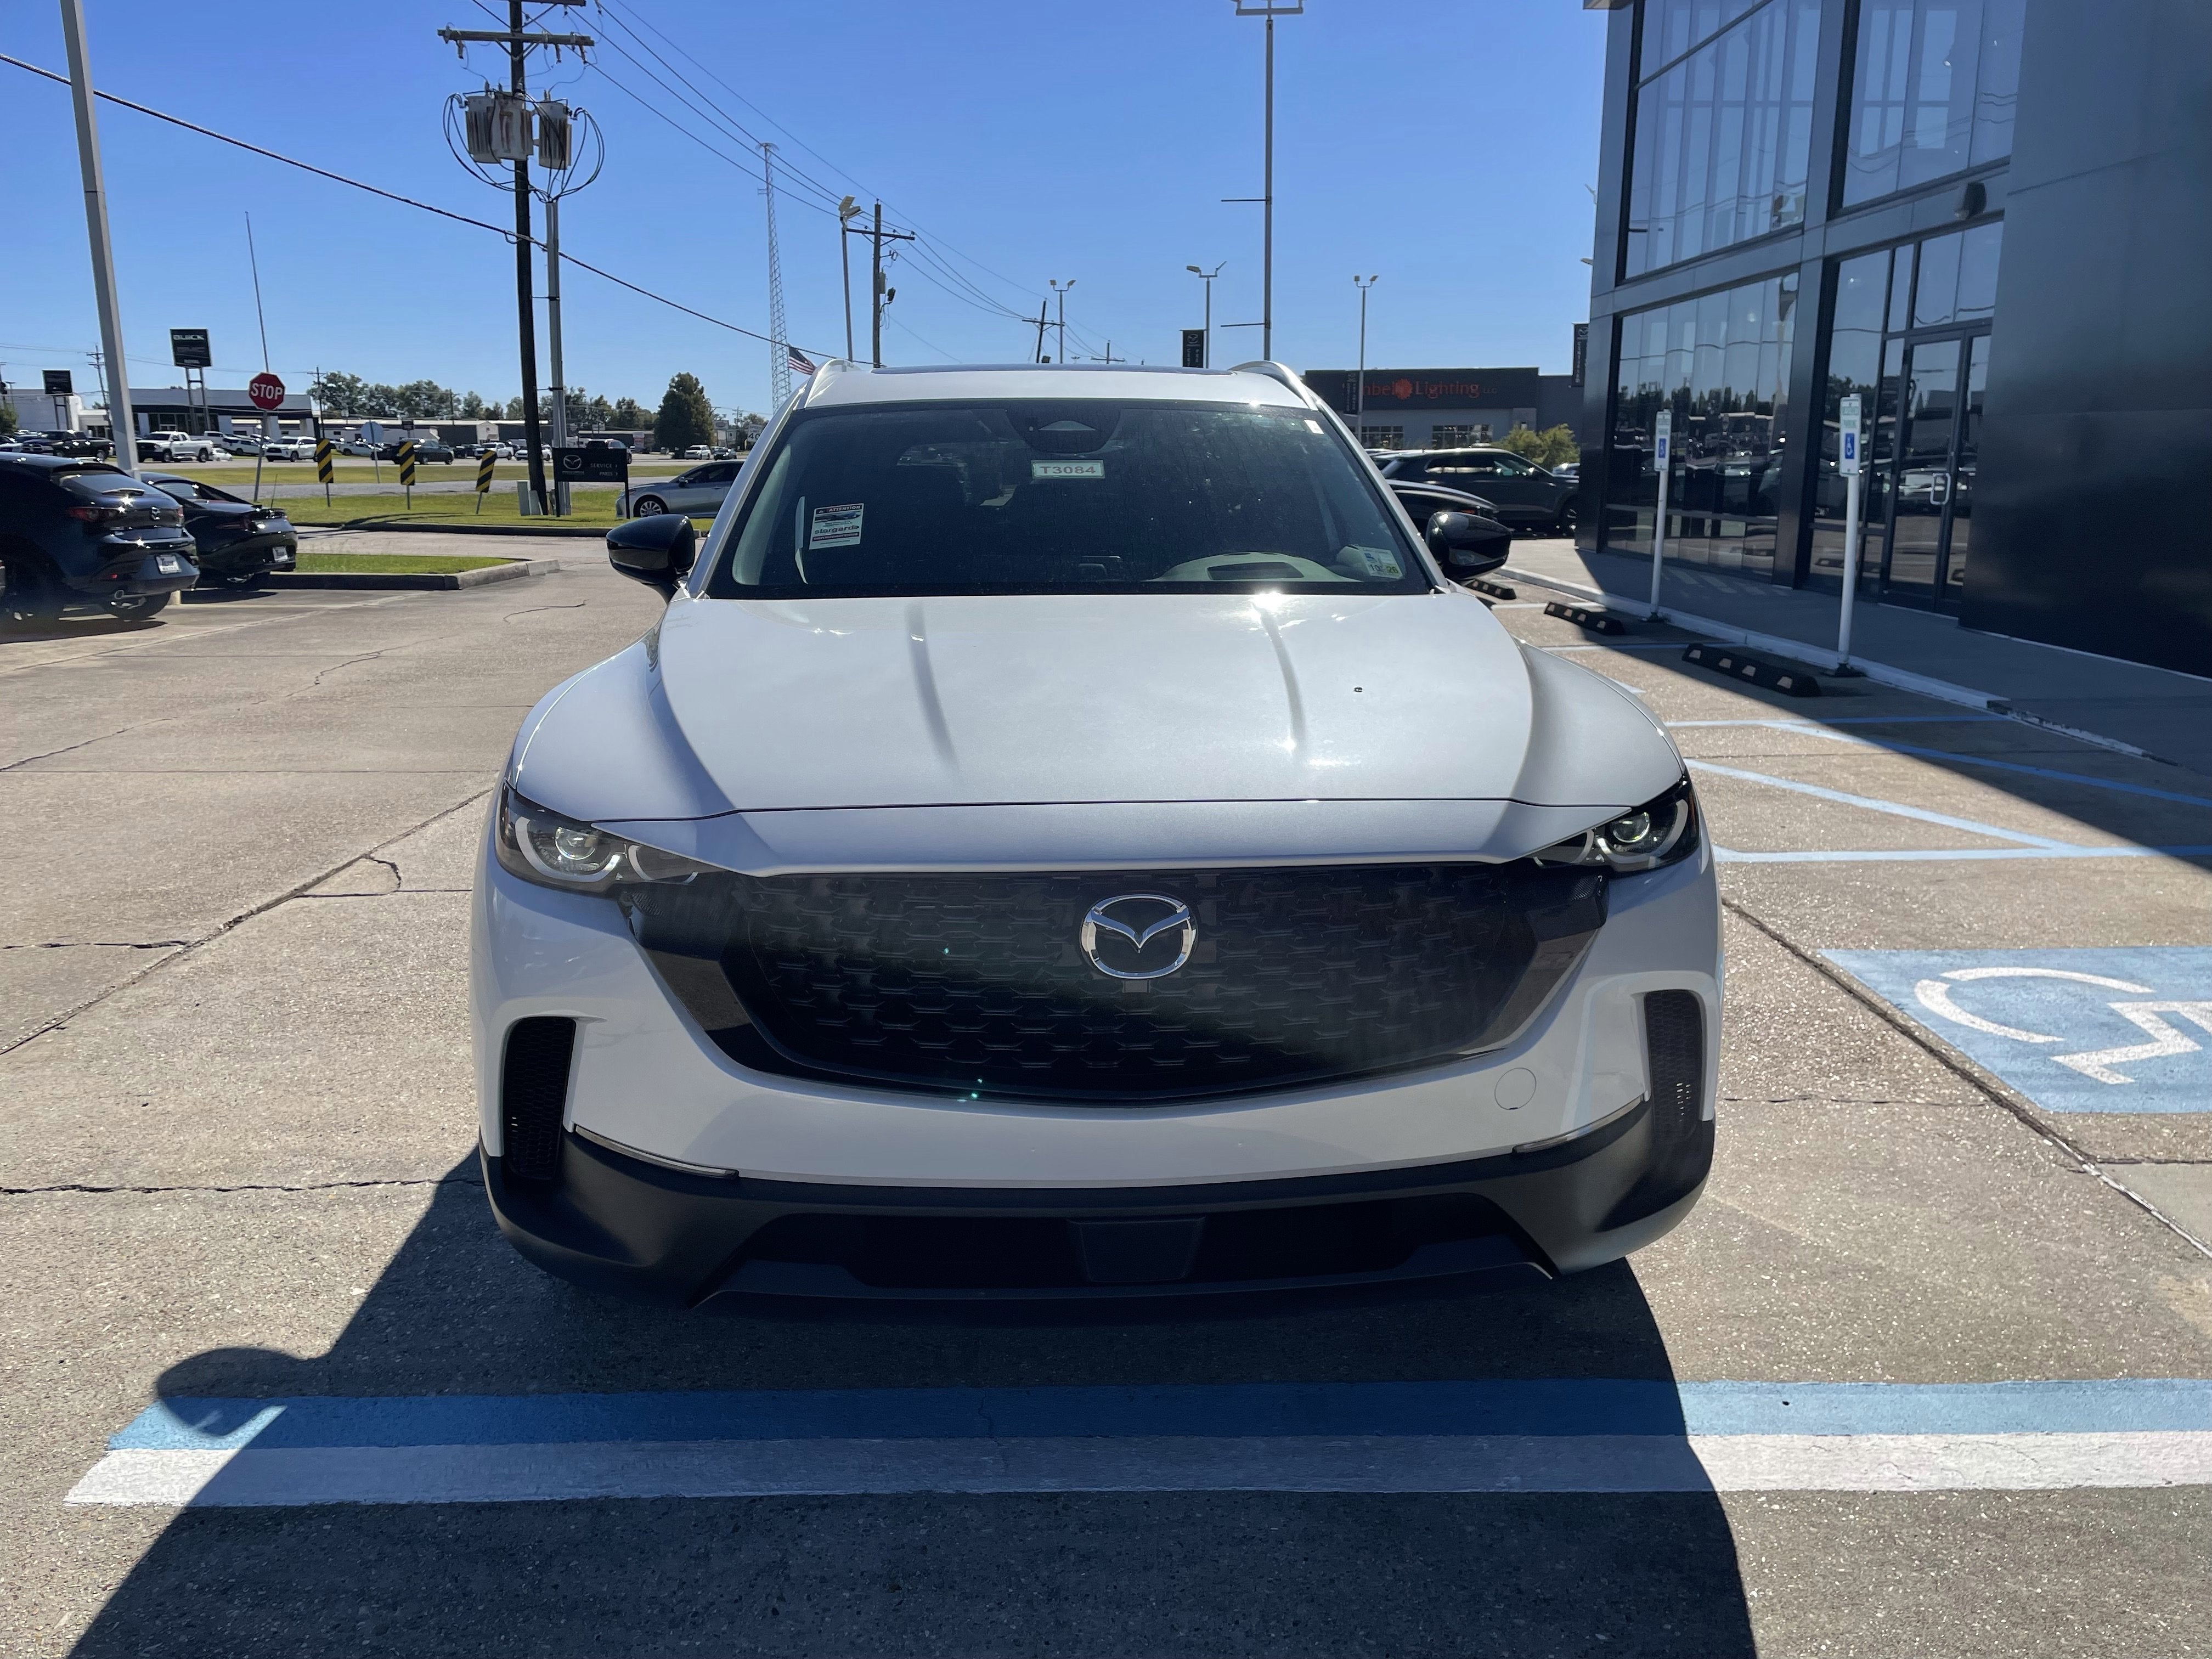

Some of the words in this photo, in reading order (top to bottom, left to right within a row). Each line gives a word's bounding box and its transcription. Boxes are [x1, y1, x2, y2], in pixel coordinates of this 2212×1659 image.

[251, 383, 283, 400] STOP
[1415, 381, 1480, 399] Lighting
[1039, 466, 1096, 474] T3084
